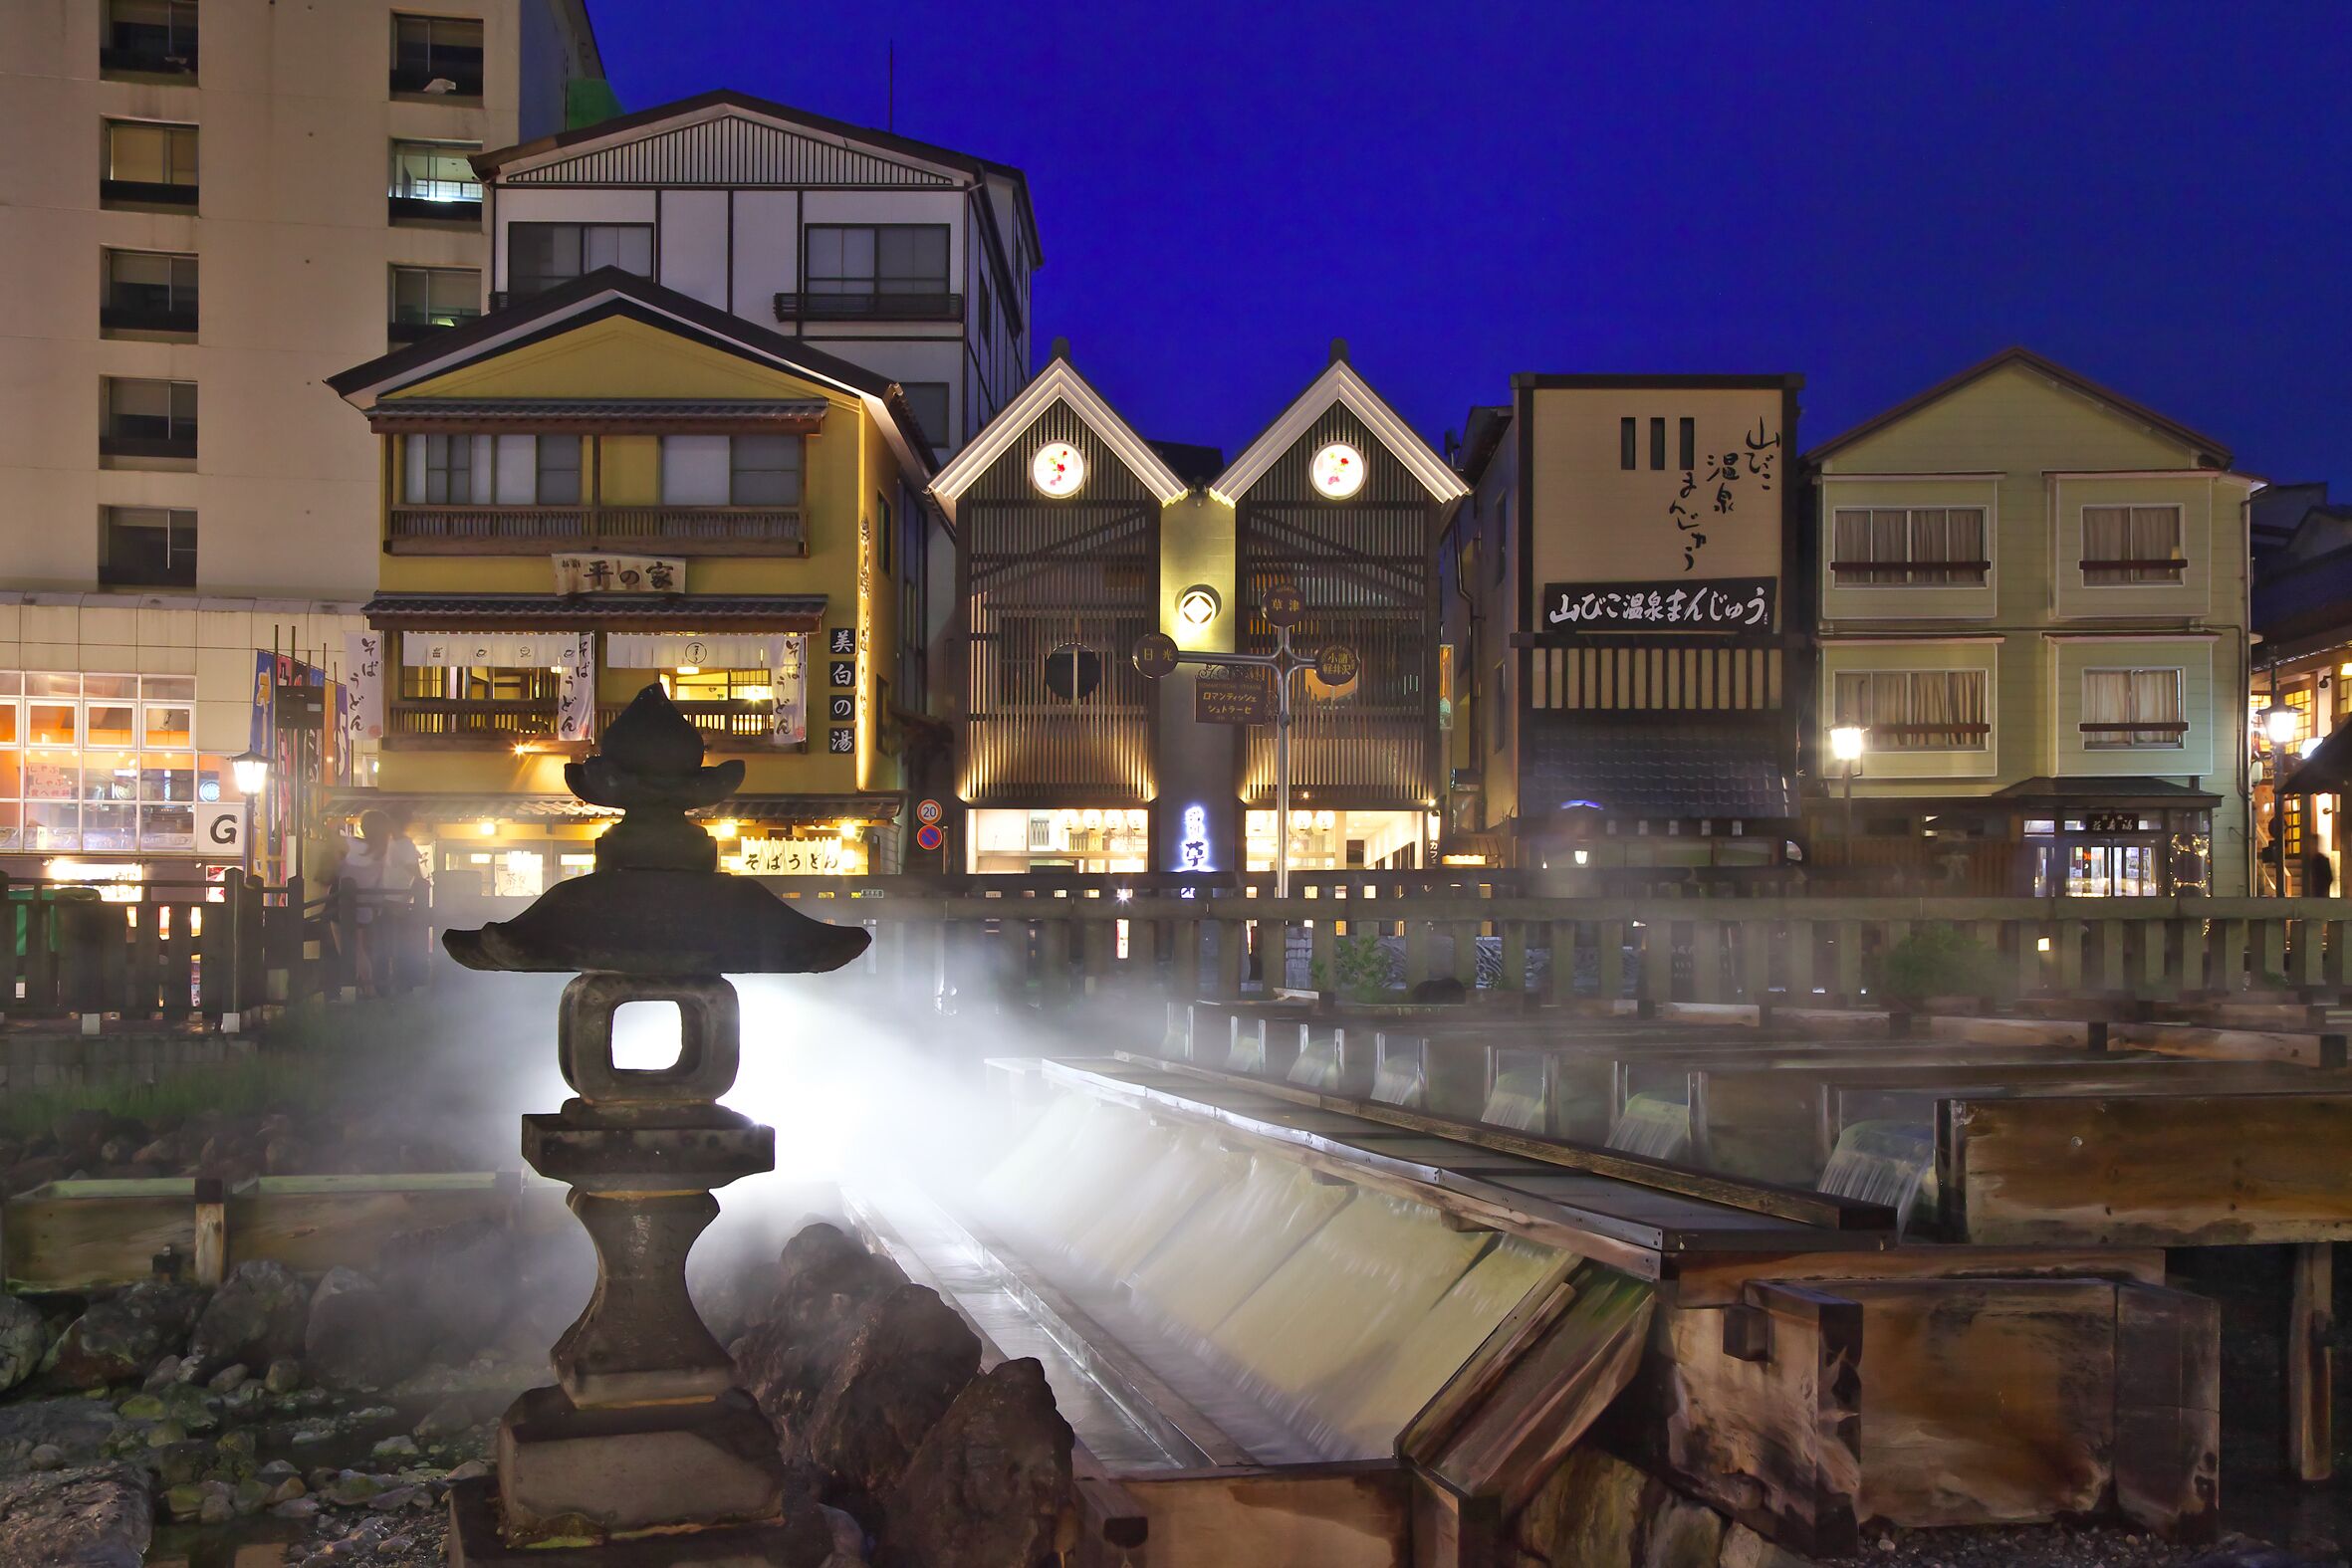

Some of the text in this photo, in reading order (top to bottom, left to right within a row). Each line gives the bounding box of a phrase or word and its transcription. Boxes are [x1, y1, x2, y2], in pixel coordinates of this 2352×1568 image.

[1745, 415, 1780, 491] 山びこ
[1706, 452, 1740, 515] 温泉
[1669, 471, 1707, 571] まんじゅう
[1549, 586, 1765, 625] 山びこ温泉まんじゅう
[361, 637, 378, 678] そば
[1143, 647, 1173, 662] 日光
[350, 672, 365, 732] うどん
[561, 674, 578, 732] うどん
[776, 675, 792, 735] うどん
[831, 629, 853, 753] 美白の湯
[1207, 705, 1252, 716] シュトラーセ
[210, 814, 237, 844] G
[921, 806, 938, 818] 20
[745, 853, 840, 871] そばうどん
